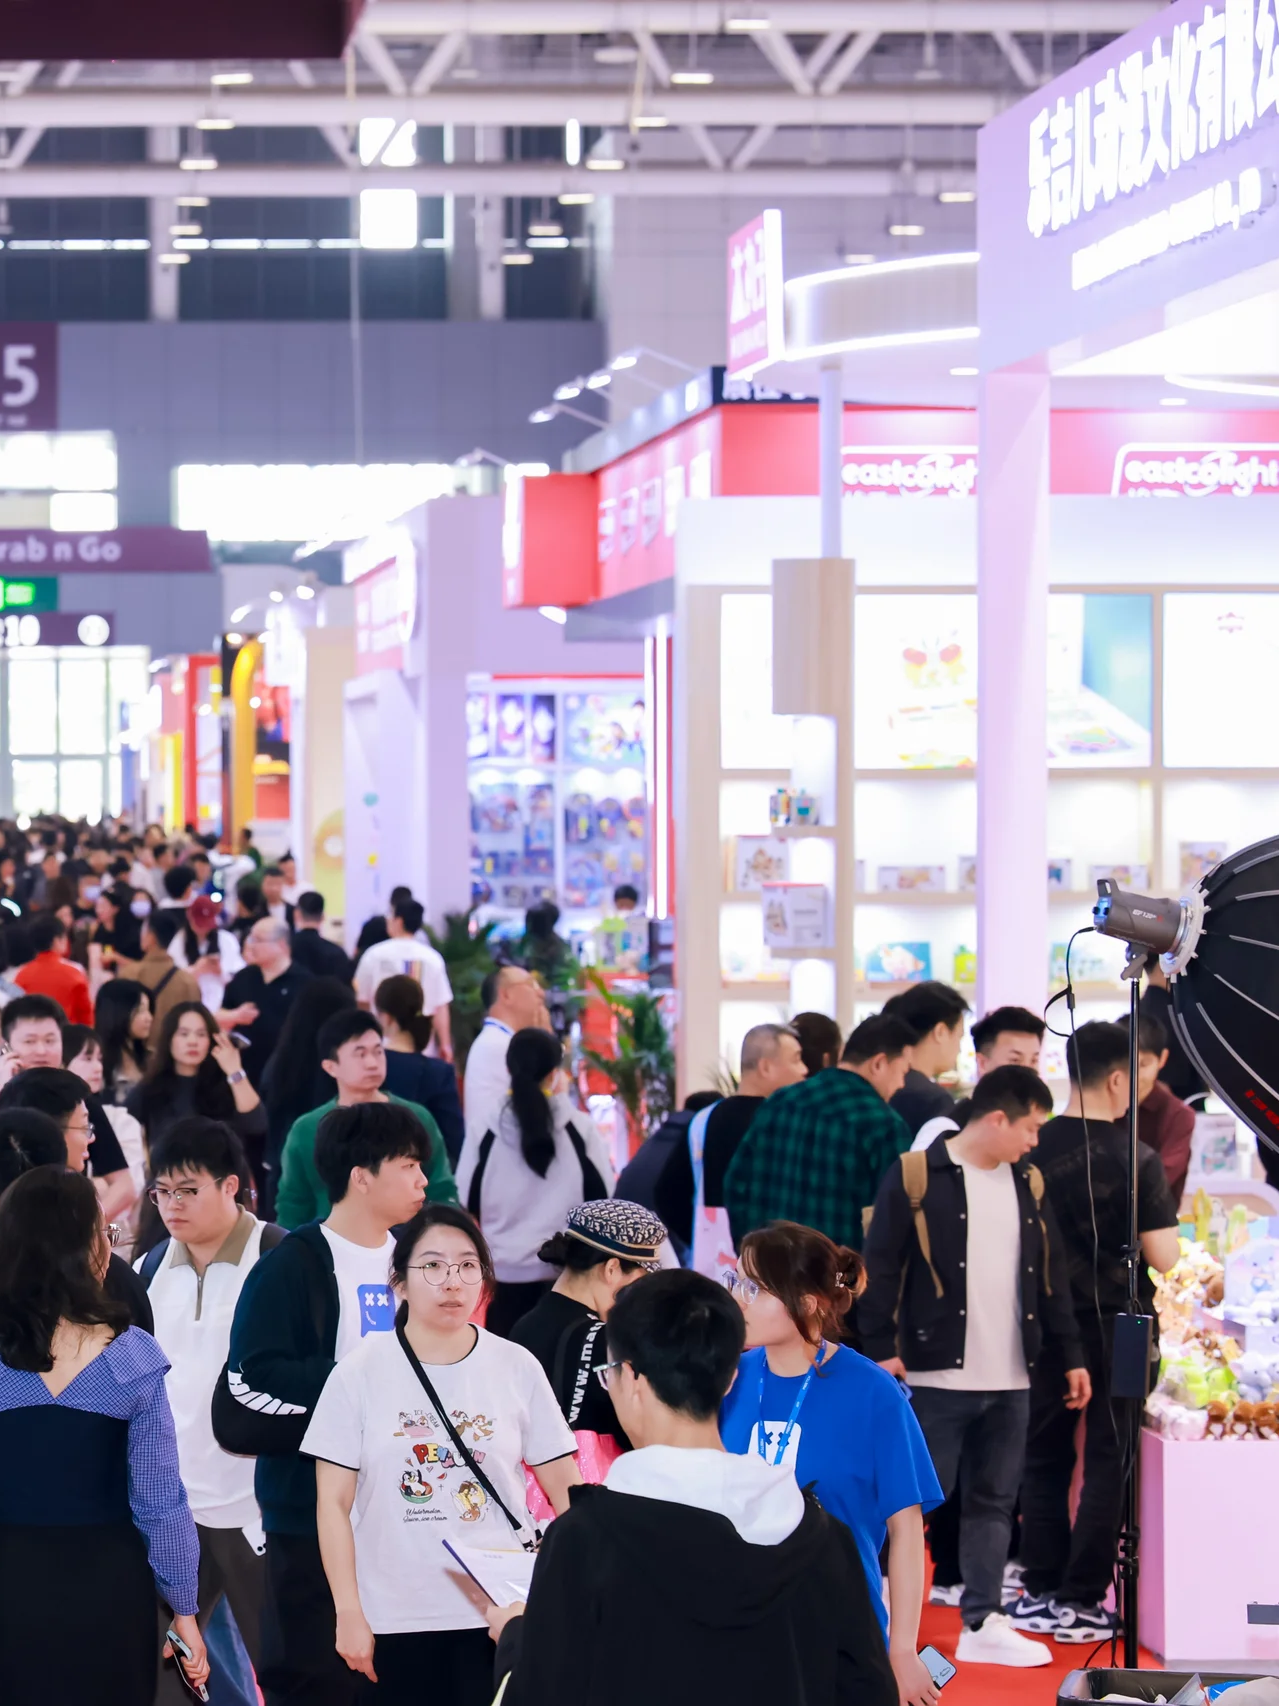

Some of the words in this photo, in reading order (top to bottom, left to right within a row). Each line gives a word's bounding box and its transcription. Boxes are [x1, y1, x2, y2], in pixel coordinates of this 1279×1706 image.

[52, 543, 72, 561] n
[78, 538, 122, 563] Go
[412, 1442, 487, 1469] PENGUN
